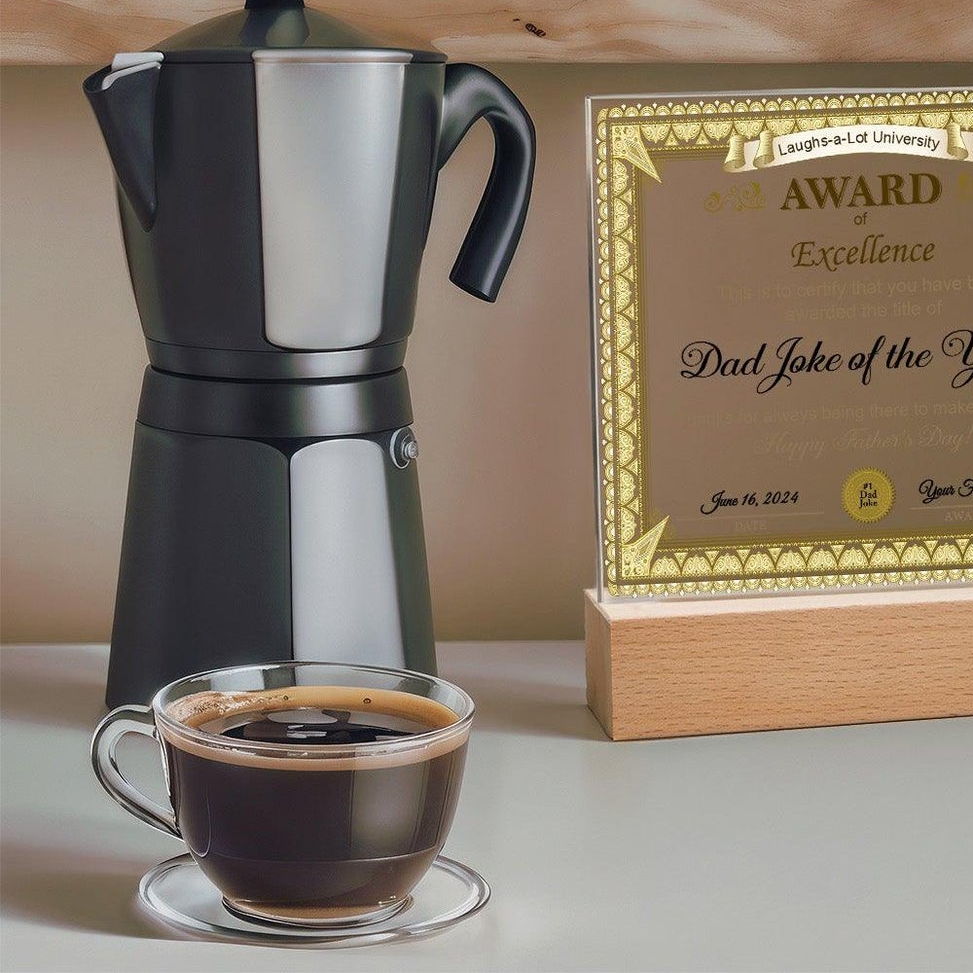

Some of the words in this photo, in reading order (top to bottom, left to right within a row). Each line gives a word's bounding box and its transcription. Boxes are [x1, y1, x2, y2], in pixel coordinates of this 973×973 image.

[777, 132, 869, 157] Laughs-a-Lot
[872, 130, 941, 152] University
[780, 172, 943, 211] AWARD
[853, 212, 868, 226] of
[791, 234, 936, 273] Excellence
[797, 280, 847, 300] certify
[851, 279, 881, 295] that
[887, 282, 917, 297] you
[922, 278, 963, 293] have
[893, 300, 921, 317] title
[926, 299, 944, 316] of
[680, 341, 766, 379] Dad
[756, 326, 844, 395] Joke
[847, 334, 886, 386] of
[885, 336, 933, 369] the
[822, 405, 866, 422] being
[870, 403, 909, 419] there
[913, 403, 929, 416] to
[859, 489, 878, 500] Dad
[862, 482, 874, 490] #1
[918, 478, 956, 505] Your
[699, 489, 740, 516] June
[740, 491, 760, 508] 16,
[761, 490, 801, 506] 2024
[857, 498, 879, 510] Joke
